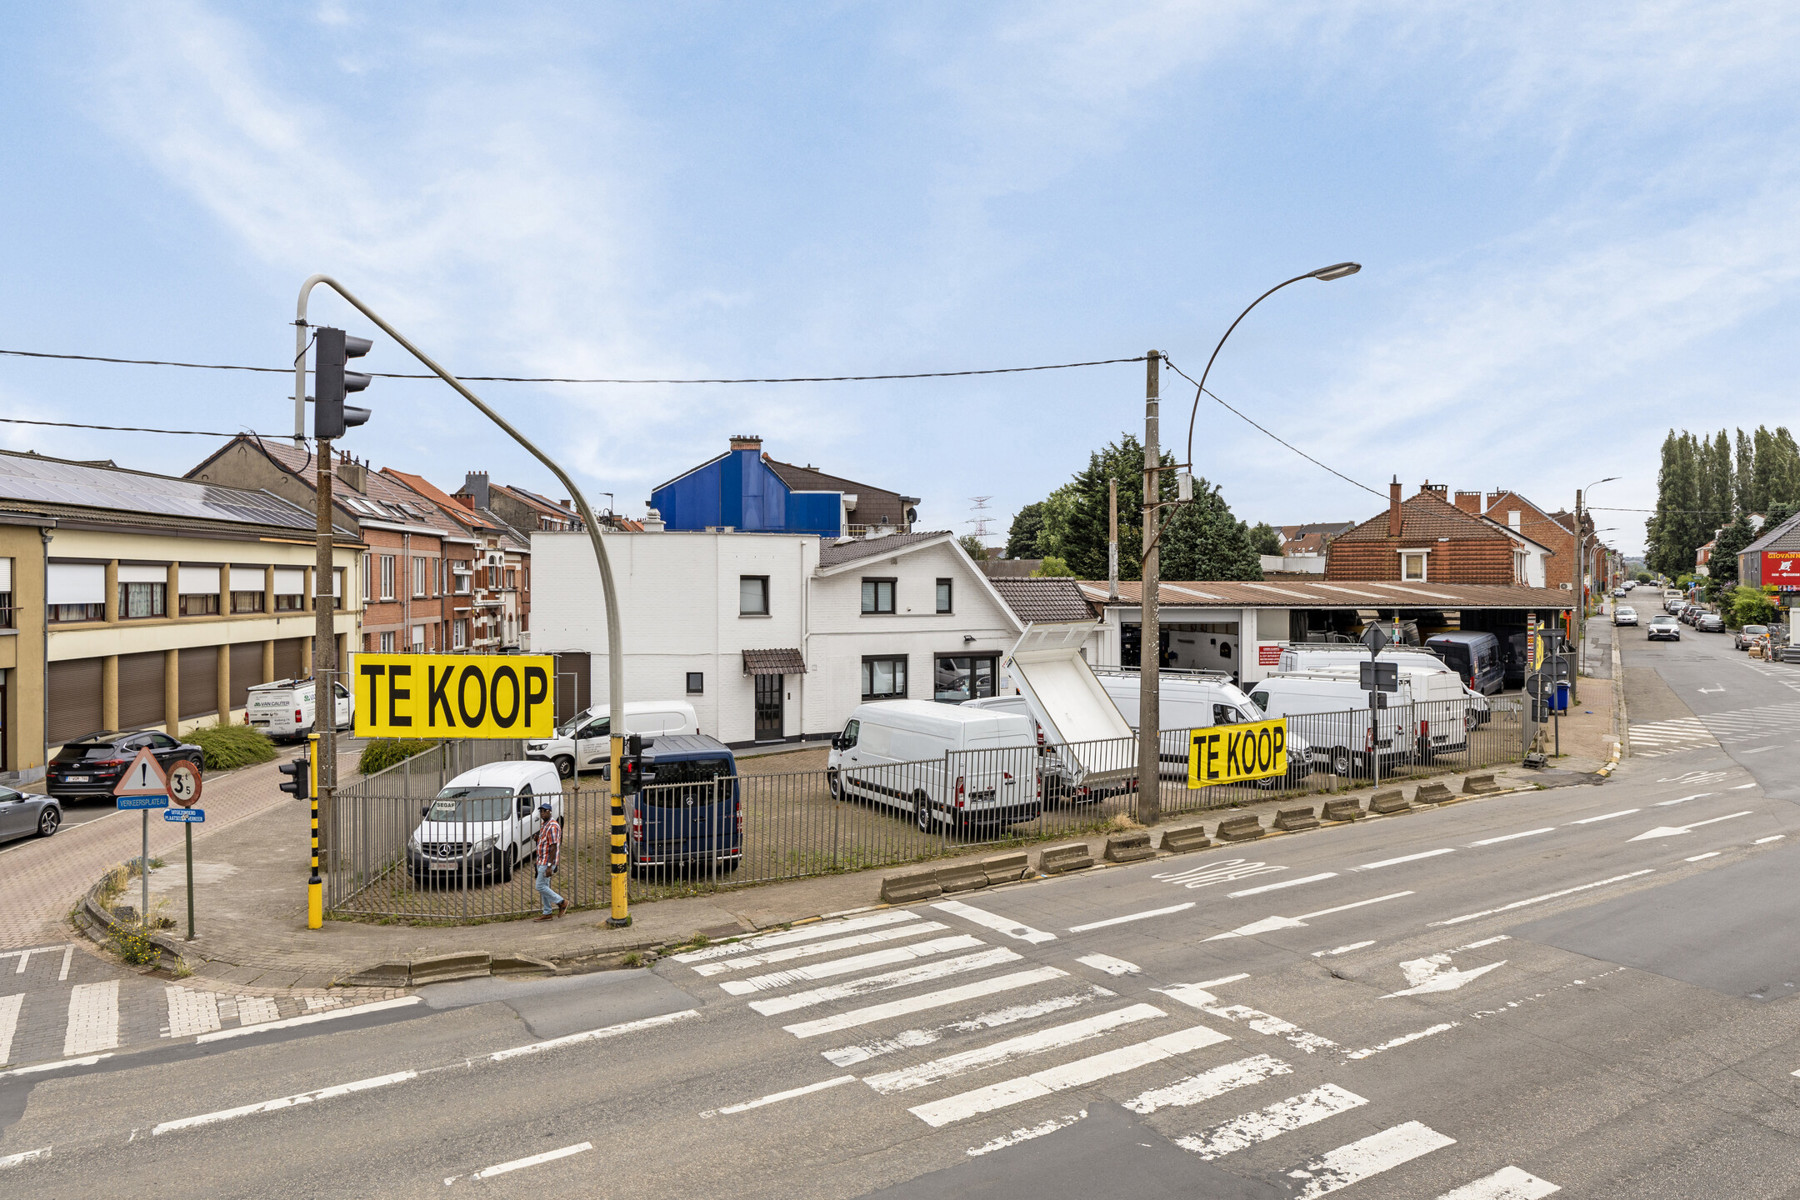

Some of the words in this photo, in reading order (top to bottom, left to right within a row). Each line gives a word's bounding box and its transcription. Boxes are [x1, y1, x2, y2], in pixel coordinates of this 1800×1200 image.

[360, 664, 412, 727] TE
[428, 664, 548, 729] KOOP
[1193, 734, 1220, 781] TE
[1227, 726, 1284, 777] KOOP
[173, 773, 184, 793] 3
[119, 797, 167, 807] VERKEERSPLATEAU
